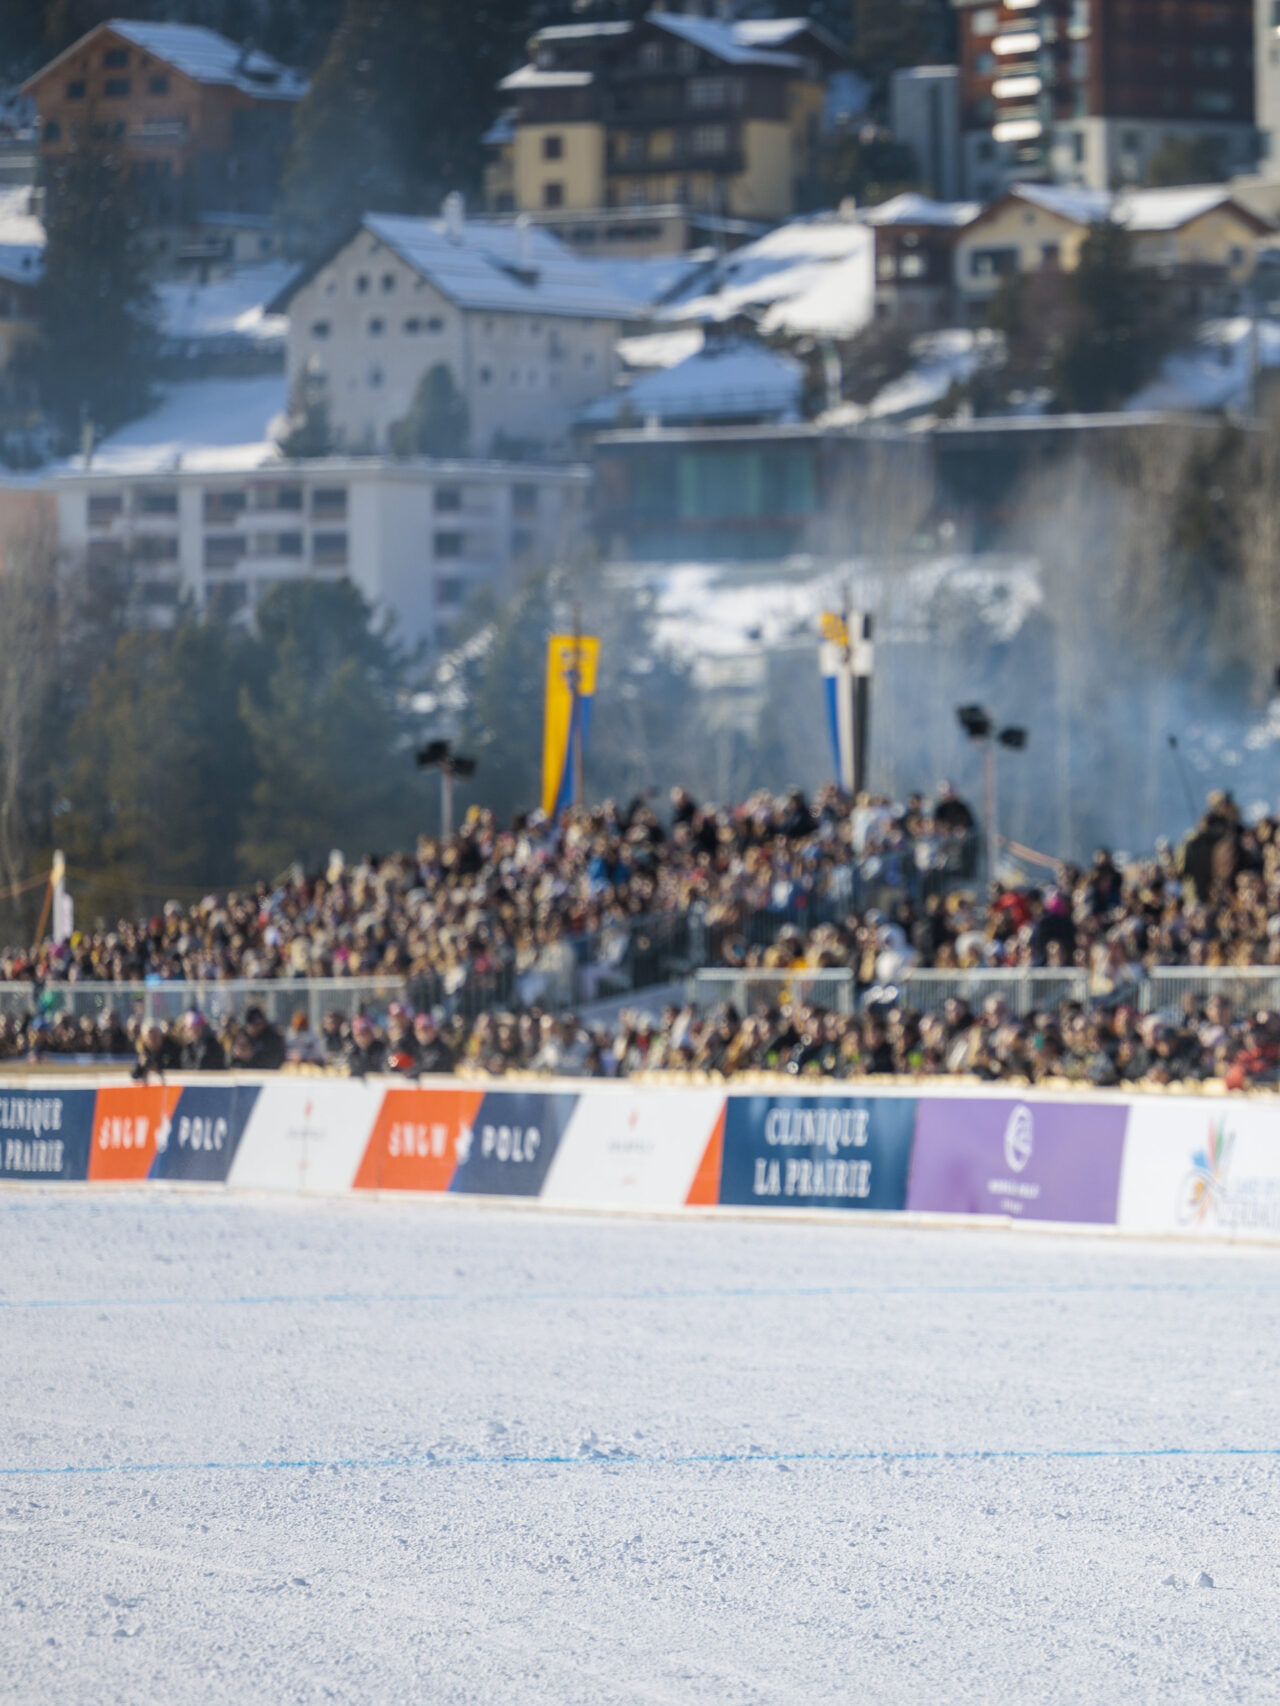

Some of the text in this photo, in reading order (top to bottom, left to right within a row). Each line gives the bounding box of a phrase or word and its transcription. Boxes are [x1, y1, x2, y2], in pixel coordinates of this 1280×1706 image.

[0, 1097, 63, 1138] LINIQUE
[764, 1107, 869, 1155] CLINIQUE
[753, 1157, 872, 1198] LA PRAIRIE
